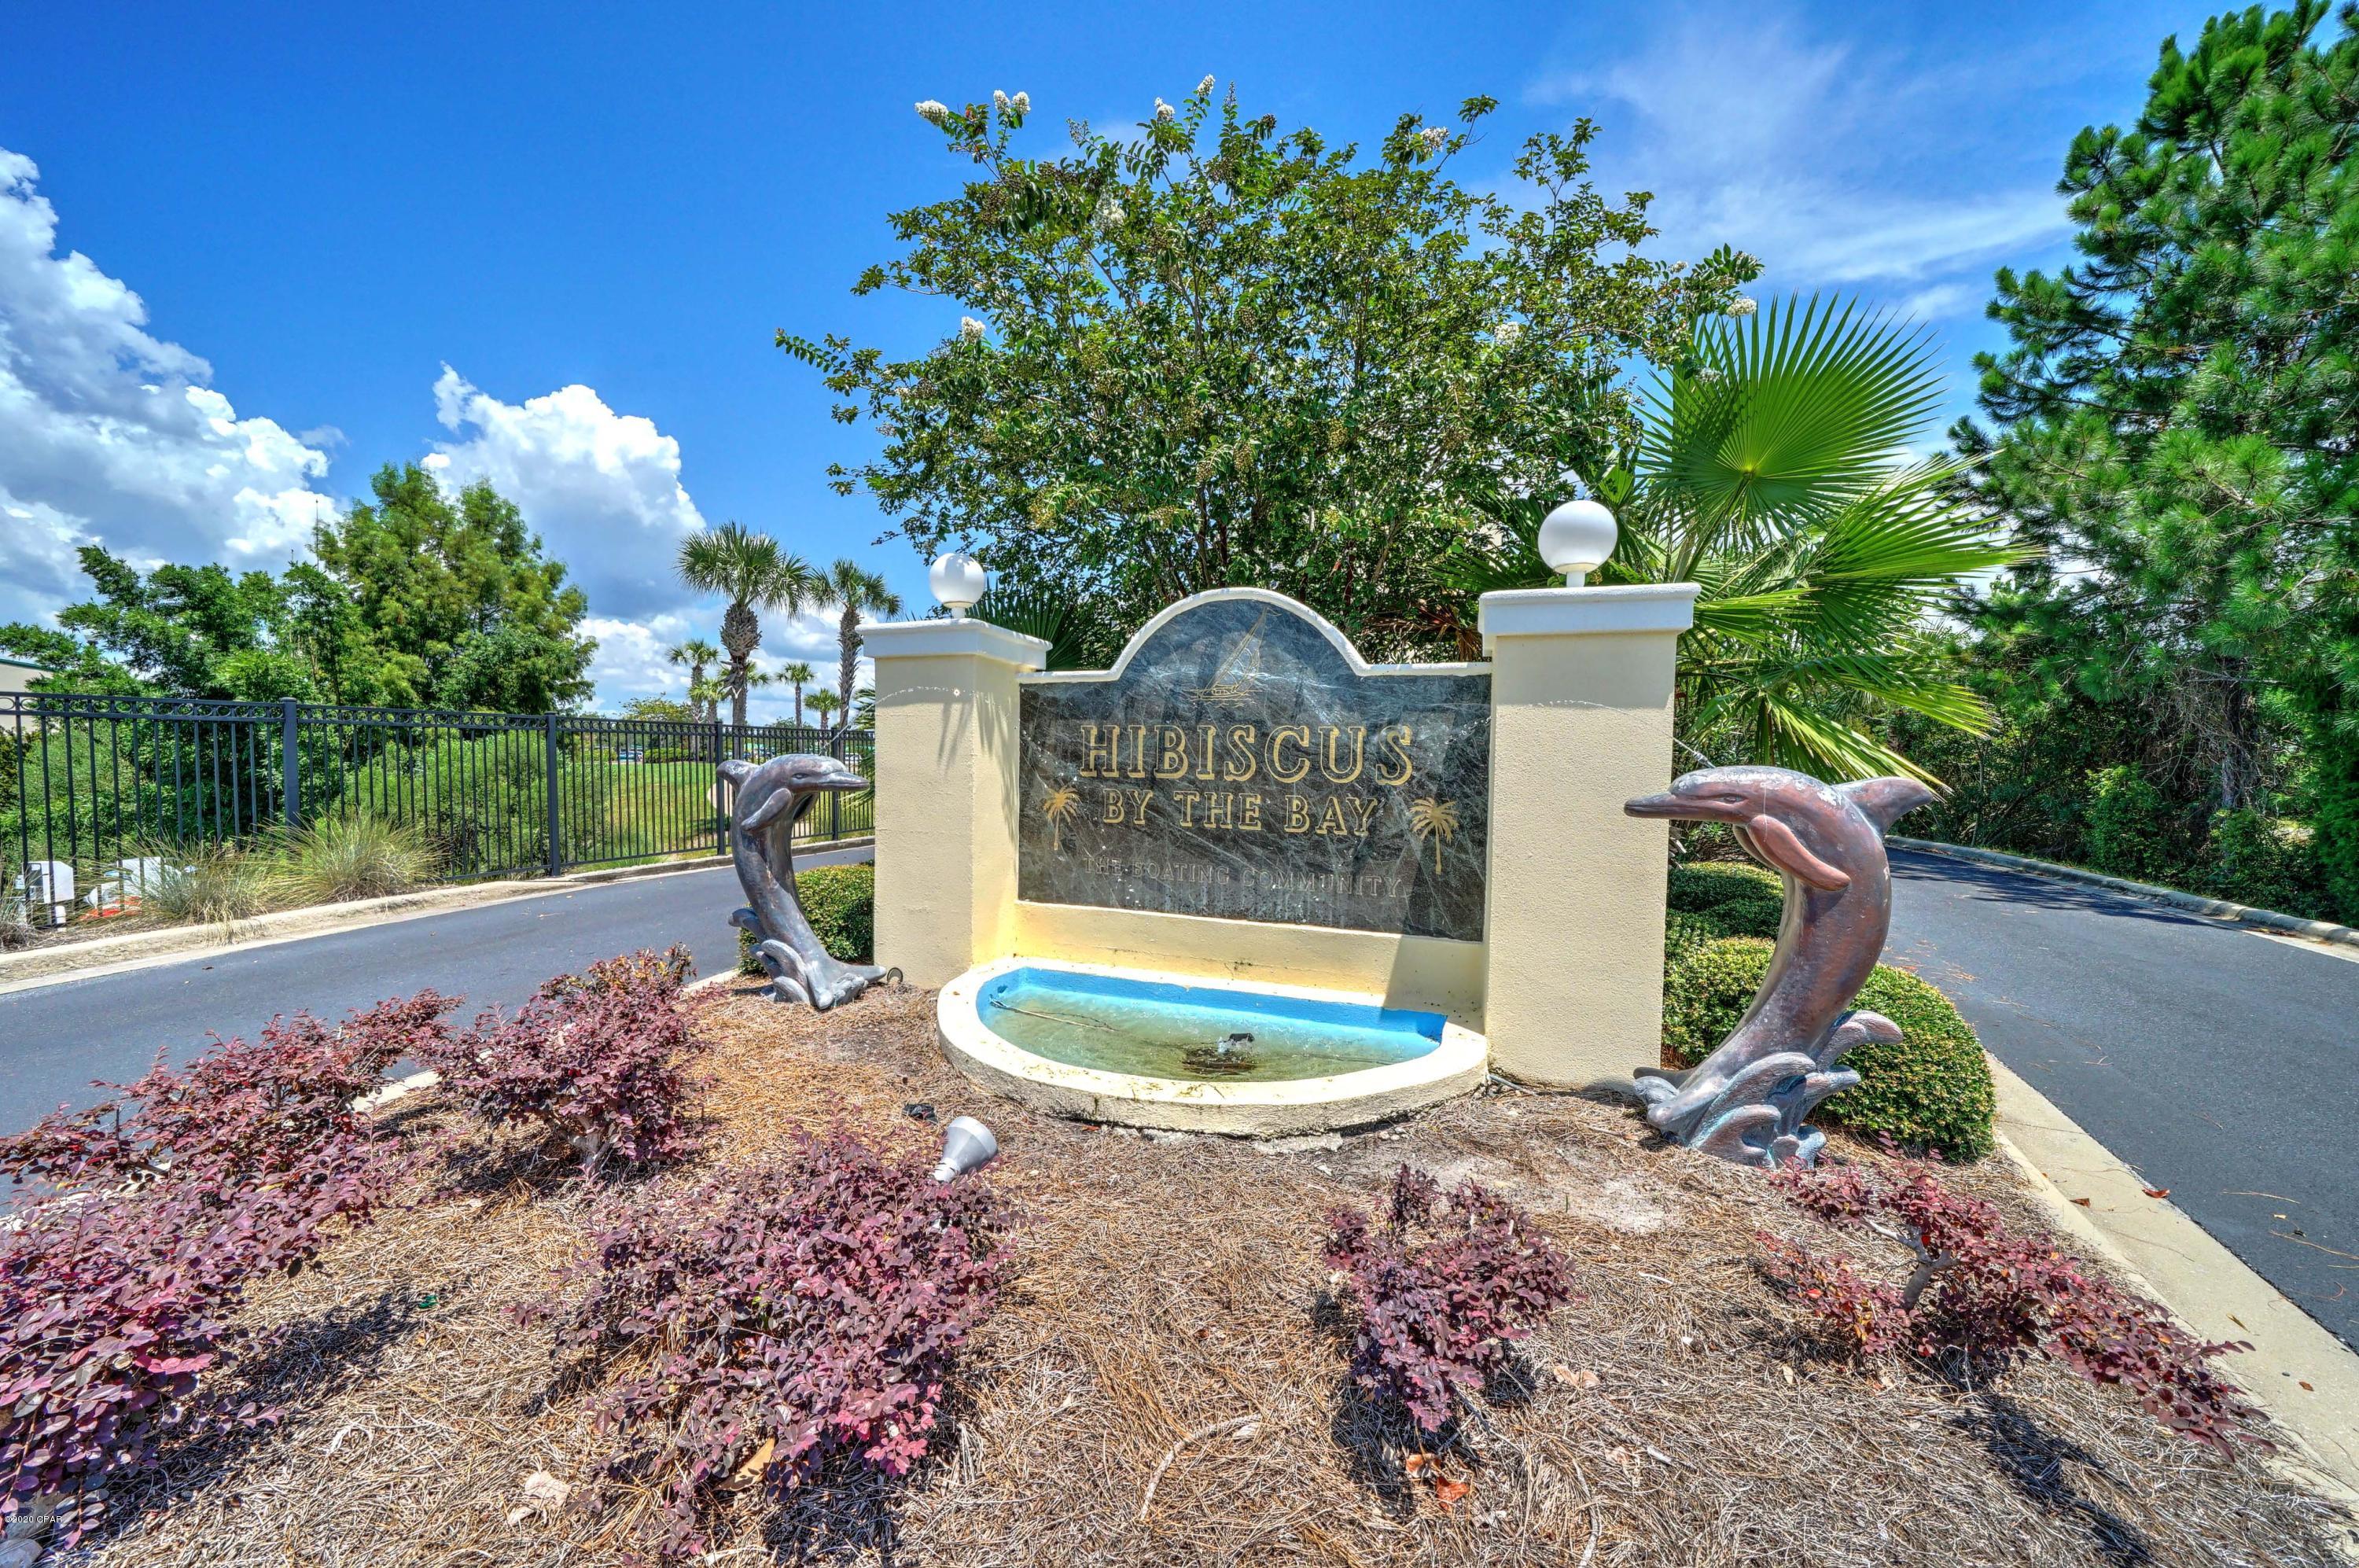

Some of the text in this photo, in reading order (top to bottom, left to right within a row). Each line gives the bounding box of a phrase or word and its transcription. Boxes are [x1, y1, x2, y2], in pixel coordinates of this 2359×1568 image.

[1080, 724, 1414, 786] HIBISCUS
[1102, 789, 1378, 836] BY THE BAY
[1084, 856, 1402, 898] THE BOATING COMMUNITY
